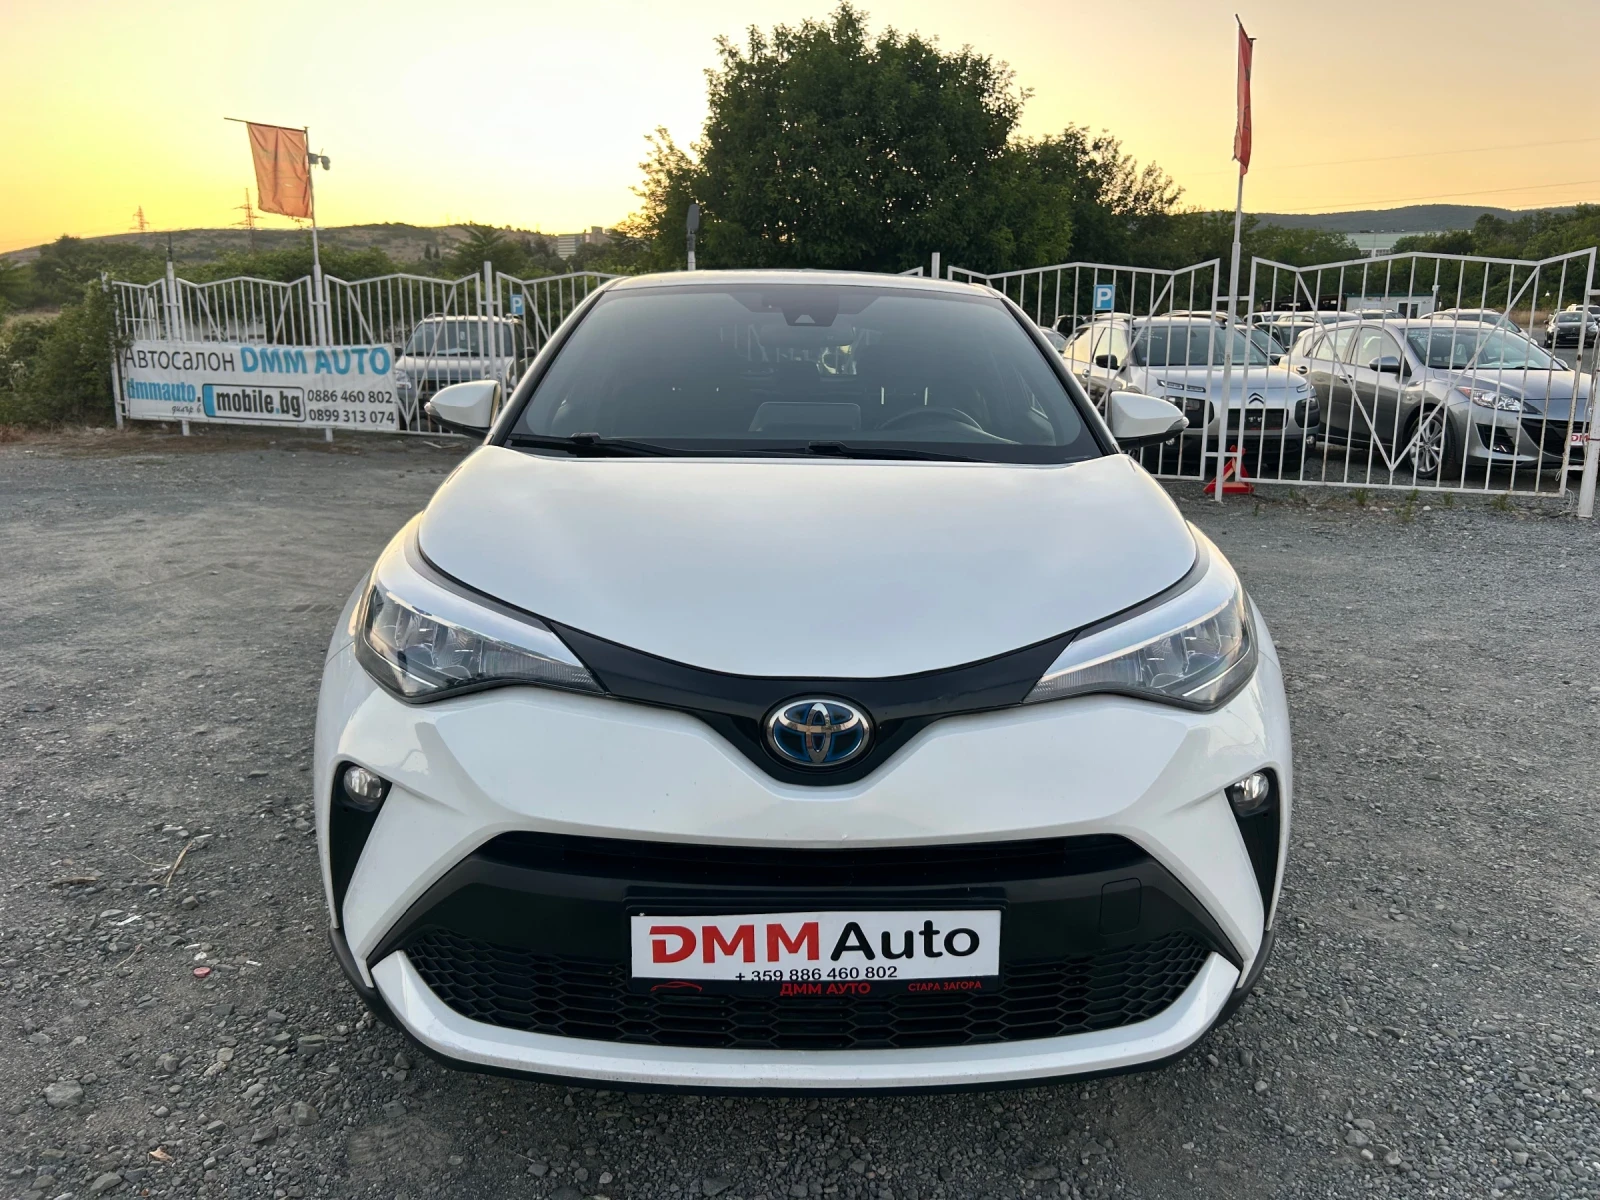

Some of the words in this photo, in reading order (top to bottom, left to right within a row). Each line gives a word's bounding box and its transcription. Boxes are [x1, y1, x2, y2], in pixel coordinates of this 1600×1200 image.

[512, 297, 522, 313] P
[1096, 287, 1112, 308] P
[124, 347, 236, 372] Автосалон
[240, 347, 308, 374] DMM
[314, 347, 391, 375] AUTO
[216, 389, 301, 418] mobile.bg
[307, 389, 338, 402] 0886
[341, 390, 365, 403] 460
[368, 391, 393, 404] 802
[309, 409, 340, 422] 0899
[343, 409, 367, 423] 313
[369, 411, 396, 424] 074
[649, 922, 820, 964] DMM
[830, 919, 980, 962] Auto
[751, 969, 784, 982] 359
[789, 968, 822, 981] 886
[826, 967, 860, 980] 460
[864, 965, 898, 979] 802
[779, 983, 824, 997] ДММ
[826, 982, 871, 995] АУТО
[908, 982, 942, 992] СТАРА
[943, 981, 982, 991] ЗАГОРА
